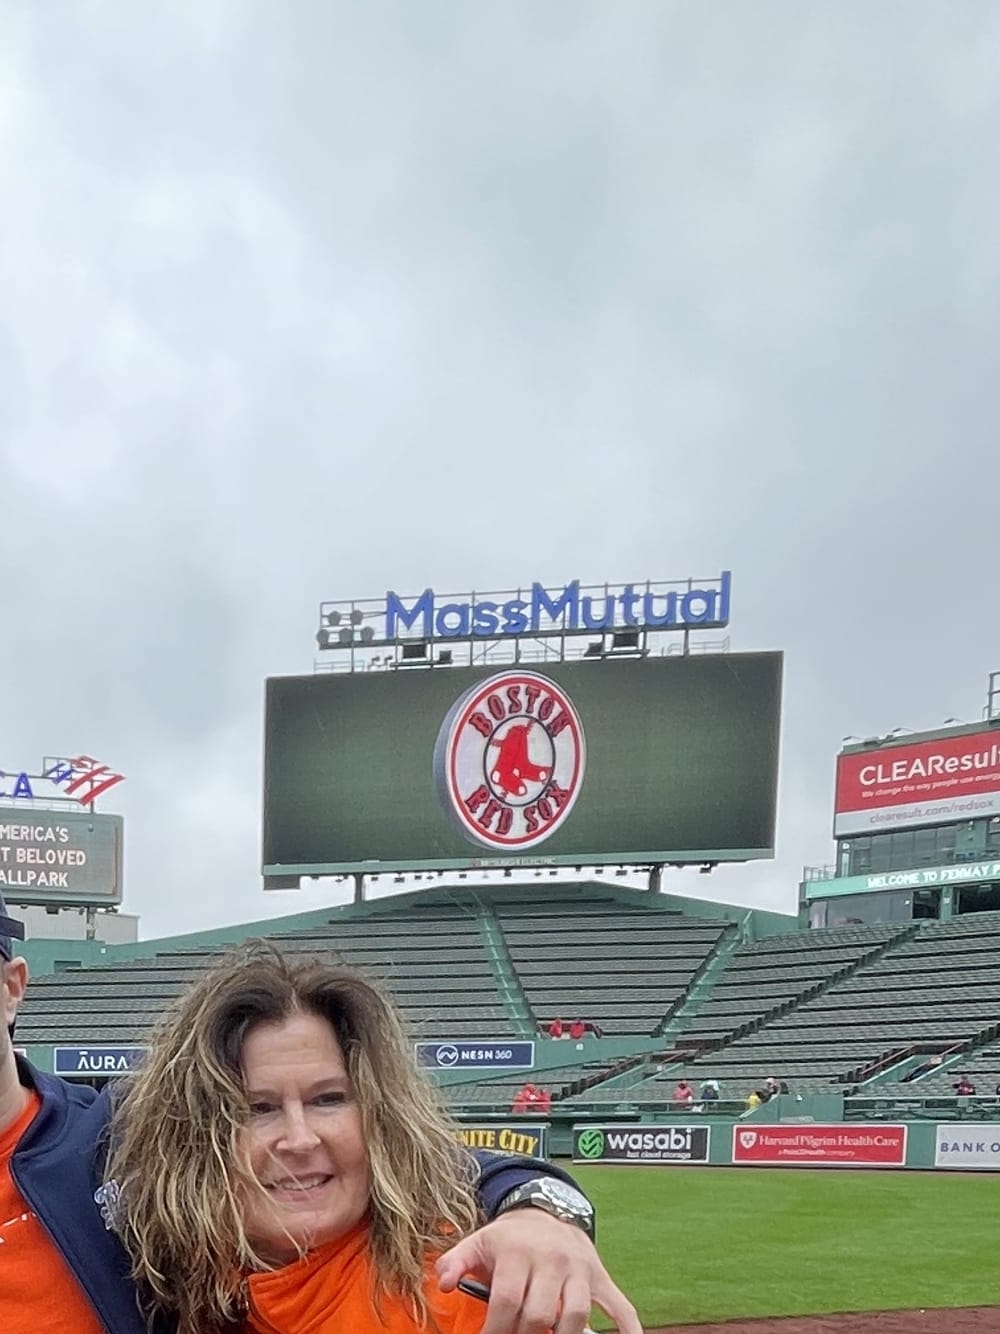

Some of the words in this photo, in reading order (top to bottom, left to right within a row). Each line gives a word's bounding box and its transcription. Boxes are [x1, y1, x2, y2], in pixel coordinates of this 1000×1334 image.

[386, 570, 731, 639] MassMutual
[469, 686, 571, 738] BOSTON
[860, 744, 1000, 786] CLEAResul
[465, 784, 513, 835] RED
[523, 779, 570, 834] SOX
[870, 799, 994, 824] clearesult.com/redsox
[16, 848, 87, 866] BELOVED
[867, 873, 920, 888] WELCOME
[923, 871, 938, 882] TO
[940, 865, 990, 881] FENWAY
[461, 1050, 493, 1060] NESN
[494, 1050, 512, 1059] 360
[456, 1130, 496, 1148] NITE
[607, 1128, 692, 1150] wasabi
[759, 1136, 800, 1147] Harvard
[800, 1135, 837, 1149] Pilgrim
[838, 1136, 873, 1147] Health
[873, 1138, 900, 1147] Care
[940, 1142, 985, 1152] BANK
[990, 1142, 1000, 1152] O
